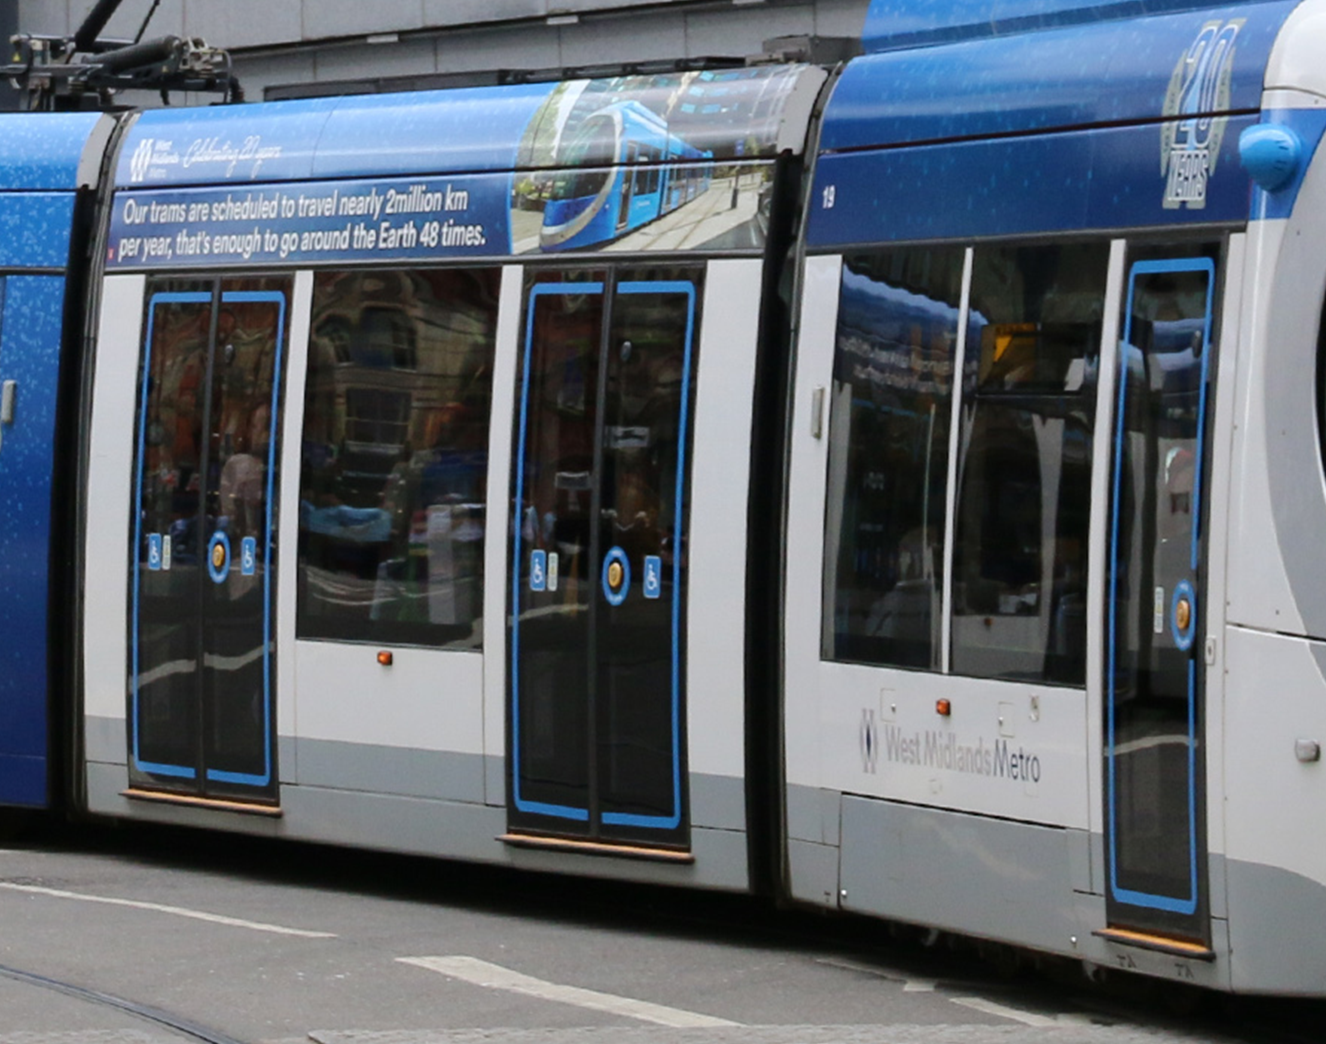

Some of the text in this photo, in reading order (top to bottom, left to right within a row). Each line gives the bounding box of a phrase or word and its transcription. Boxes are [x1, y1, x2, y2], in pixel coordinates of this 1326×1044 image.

[123, 184, 468, 225] Our trams are scheduled to travel nearly 2million km
[823, 184, 835, 209] 19
[117, 236, 141, 263] per
[141, 236, 173, 263] year,
[176, 228, 210, 256] that's
[213, 226, 261, 260] enough
[264, 228, 278, 251] to
[280, 232, 299, 258] go
[301, 222, 351, 251] around
[353, 222, 376, 249] the
[378, 219, 416, 249] Earth
[419, 222, 440, 248] 48
[441, 219, 486, 247] times.
[885, 724, 1041, 783] West Midlands Metro
